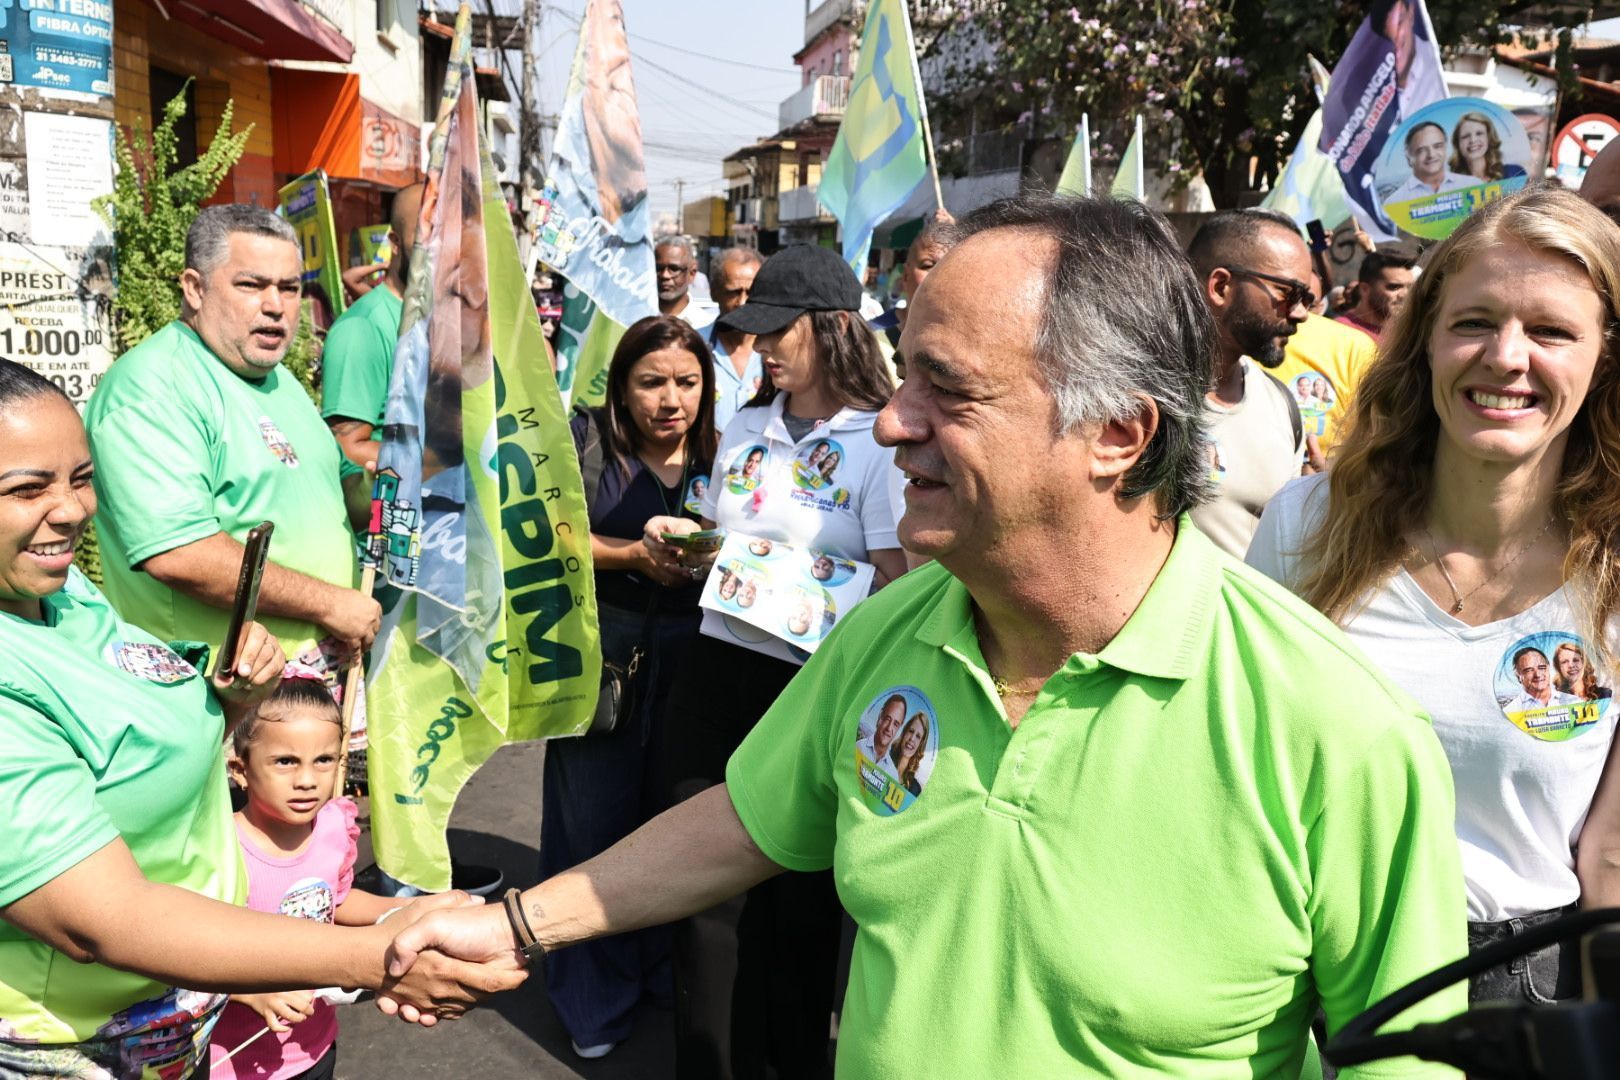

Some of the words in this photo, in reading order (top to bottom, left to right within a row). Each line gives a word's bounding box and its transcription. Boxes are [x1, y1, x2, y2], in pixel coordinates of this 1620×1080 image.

[36, 16, 80, 34] FIBRA
[1, 271, 70, 290] PREST
[14, 315, 63, 327] RECEBA
[48, 361, 67, 371] EM
[518, 407, 585, 607] MARCOS
